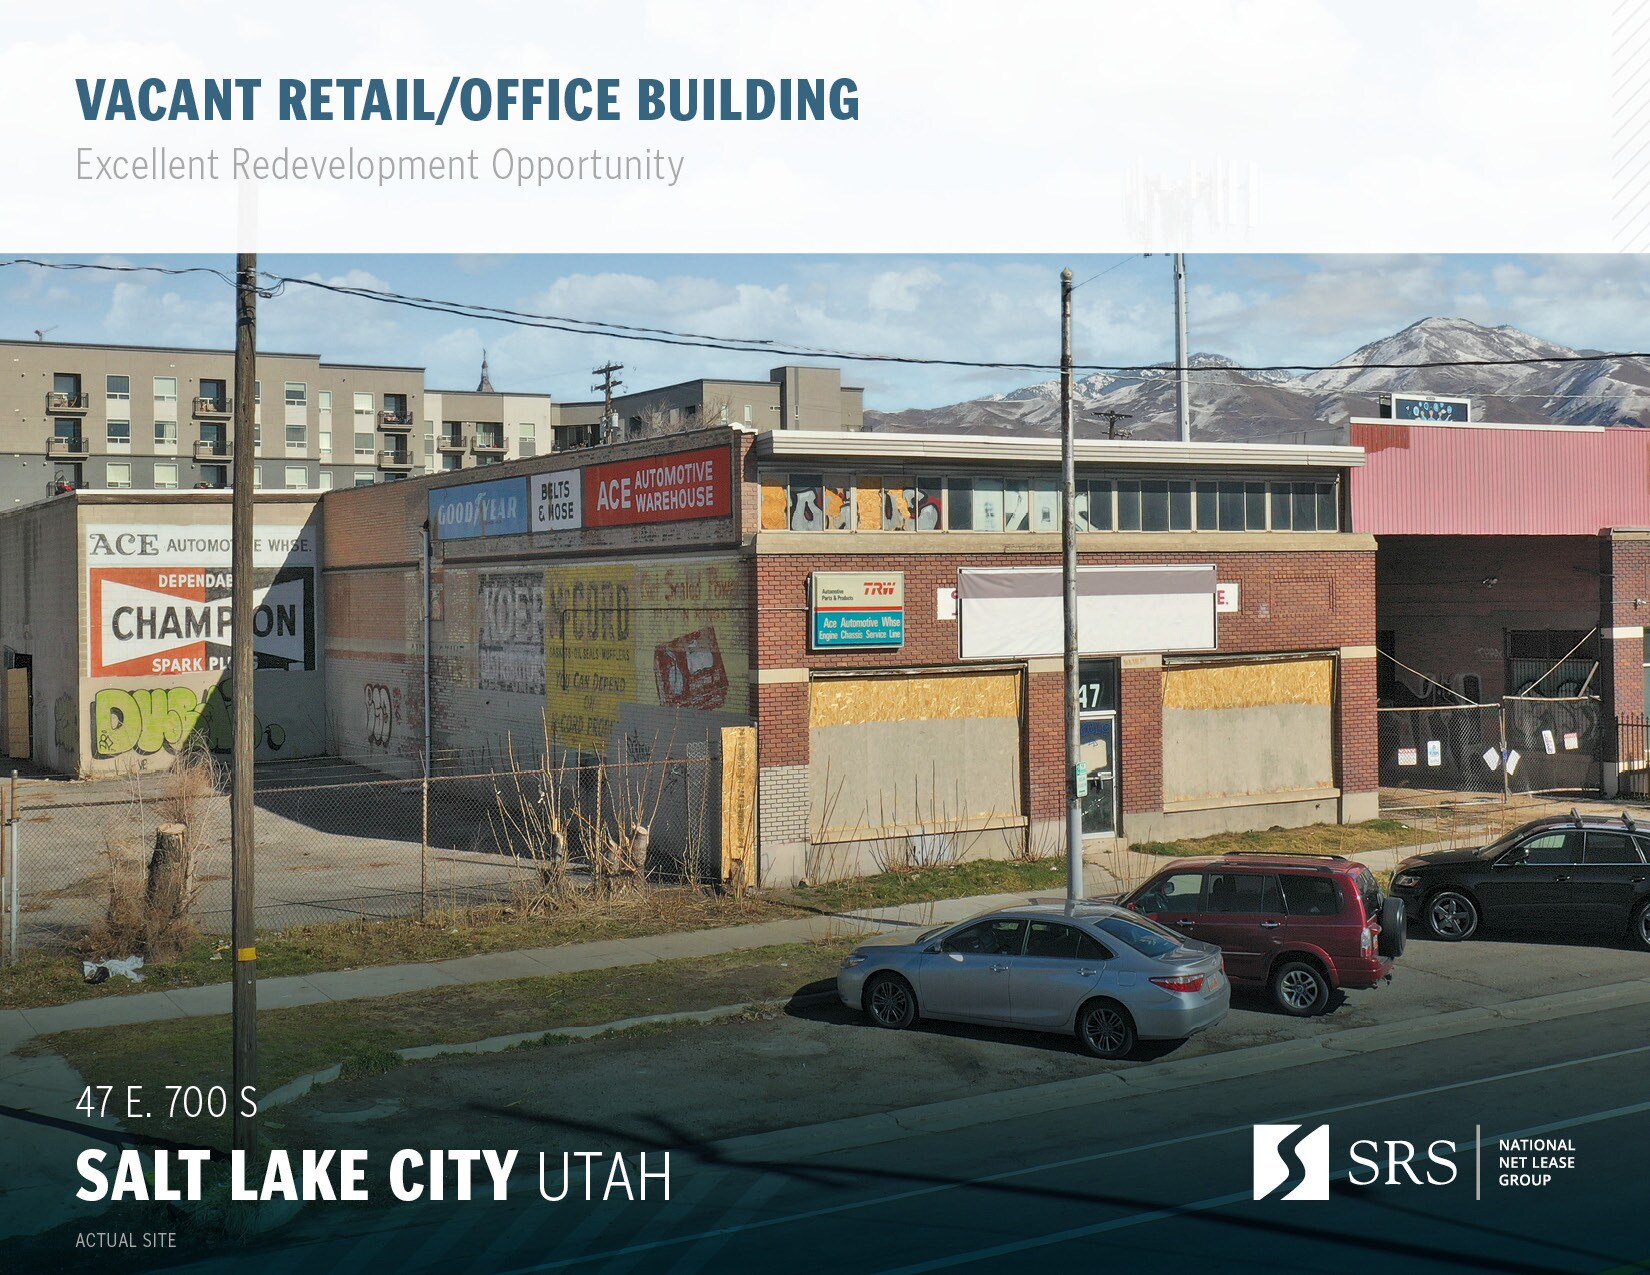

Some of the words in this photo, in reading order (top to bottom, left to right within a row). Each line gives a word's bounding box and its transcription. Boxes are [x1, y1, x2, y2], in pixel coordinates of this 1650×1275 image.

[541, 480, 570, 501] BELTS
[597, 478, 631, 511] ACE
[634, 460, 713, 490] AUTOMOTIVE
[635, 485, 714, 513] WAREHOUSE
[538, 505, 545, 522] &
[89, 533, 159, 556] ACE
[268, 538, 313, 553] WHSE.
[863, 582, 896, 595] TRW
[112, 605, 295, 641] CHAMPON
[823, 618, 837, 629] Ace
[840, 617, 878, 628] Automotive
[882, 616, 900, 627] Whse
[819, 631, 838, 641] Engine
[841, 630, 863, 640] Chassis
[865, 630, 886, 639] Service
[889, 629, 900, 639] Line
[152, 657, 203, 673] SPARK
[1078, 684, 1100, 708] 47
